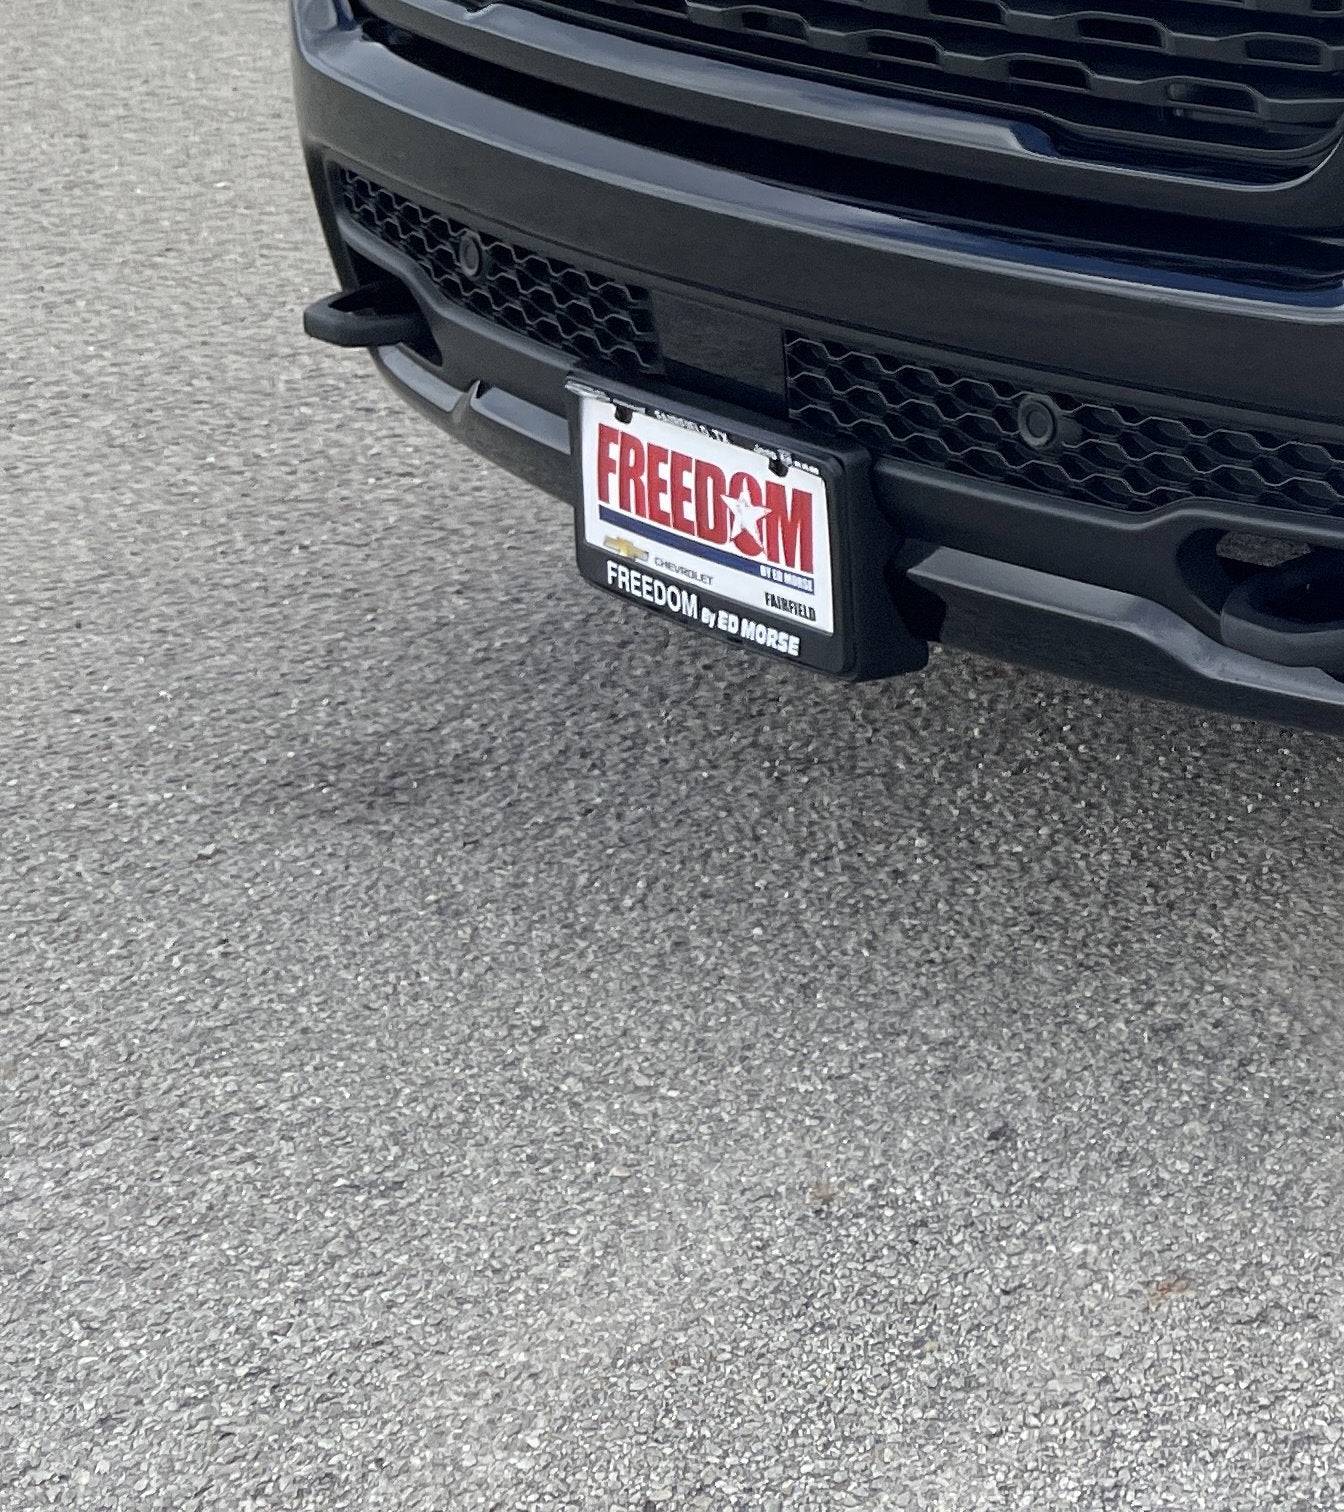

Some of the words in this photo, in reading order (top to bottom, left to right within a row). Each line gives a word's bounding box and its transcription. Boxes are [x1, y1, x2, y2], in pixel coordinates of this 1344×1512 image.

[598, 423, 813, 575] FREEDOM
[654, 557, 713, 586] CHEVROLET
[606, 559, 698, 620] FREEDOM
[717, 609, 739, 635] ED
[740, 618, 800, 657] MORSE
[764, 591, 817, 622] FAIRFIELD
